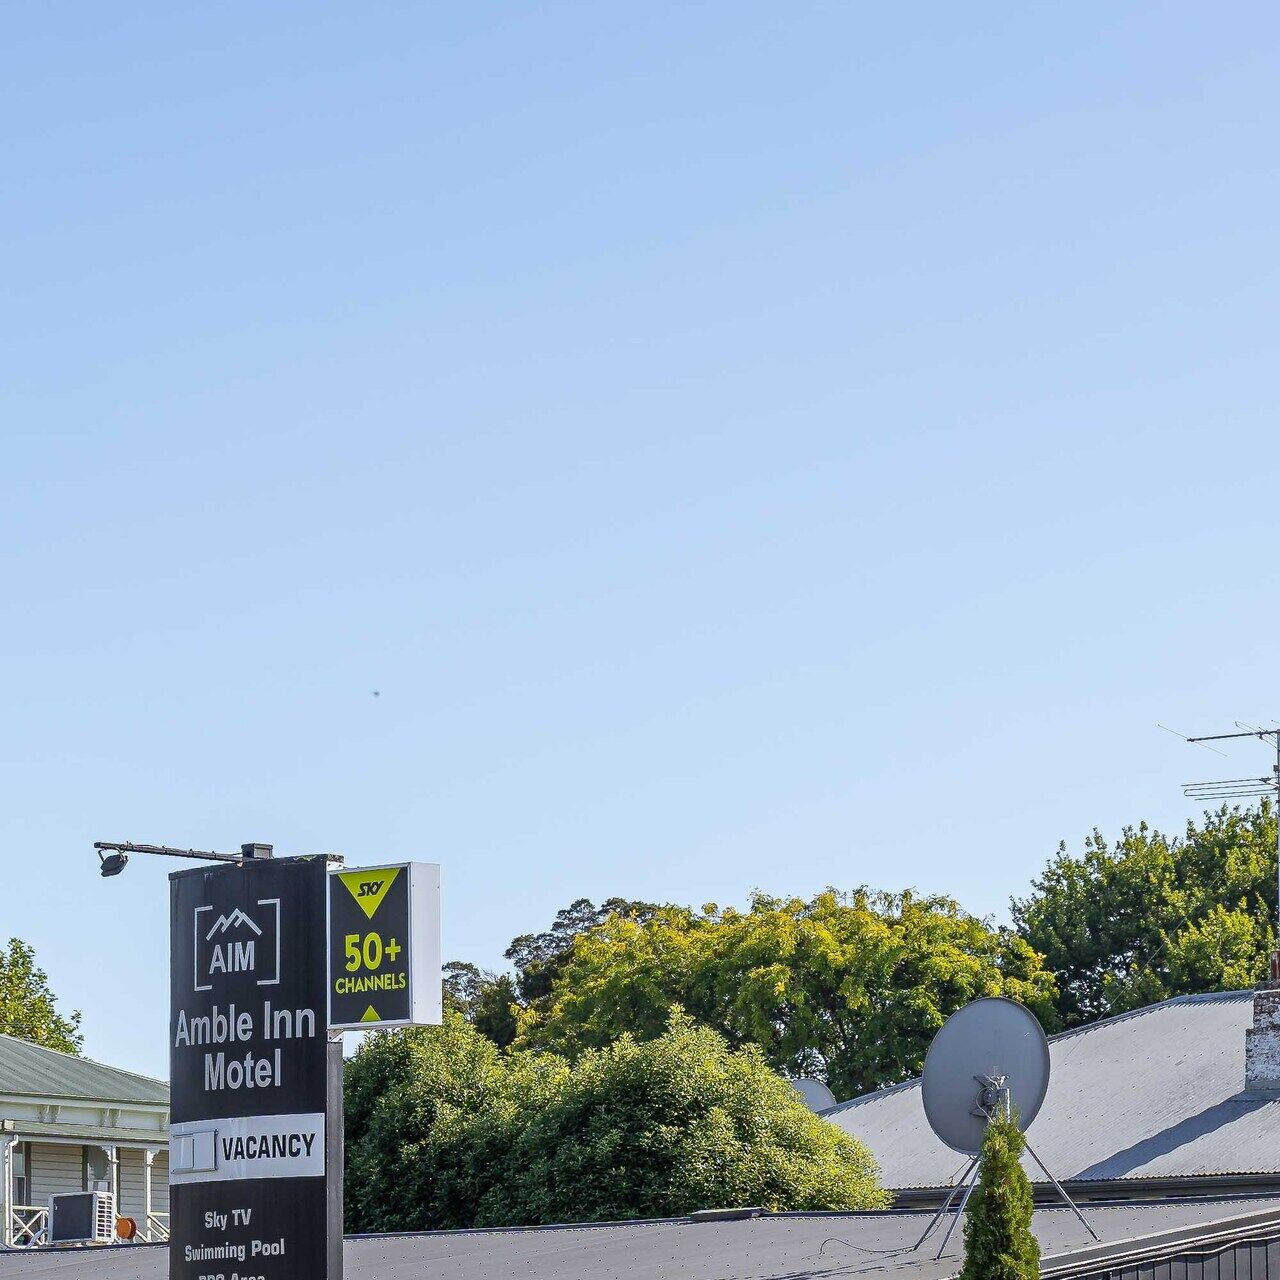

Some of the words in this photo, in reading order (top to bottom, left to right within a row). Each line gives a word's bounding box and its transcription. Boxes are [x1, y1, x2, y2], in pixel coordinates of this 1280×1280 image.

[208, 941, 255, 975] AIM
[344, 932, 402, 972] 50+
[335, 972, 406, 994] CHANNELS
[175, 1005, 253, 1048] Amble
[264, 1001, 315, 1040] Inn
[204, 1048, 281, 1091] Motel
[222, 1133, 316, 1161] VACANCY
[204, 1211, 228, 1231] Sky
[232, 1208, 252, 1226] TV
[185, 1241, 246, 1262] Swimming
[251, 1238, 285, 1257] Pool
